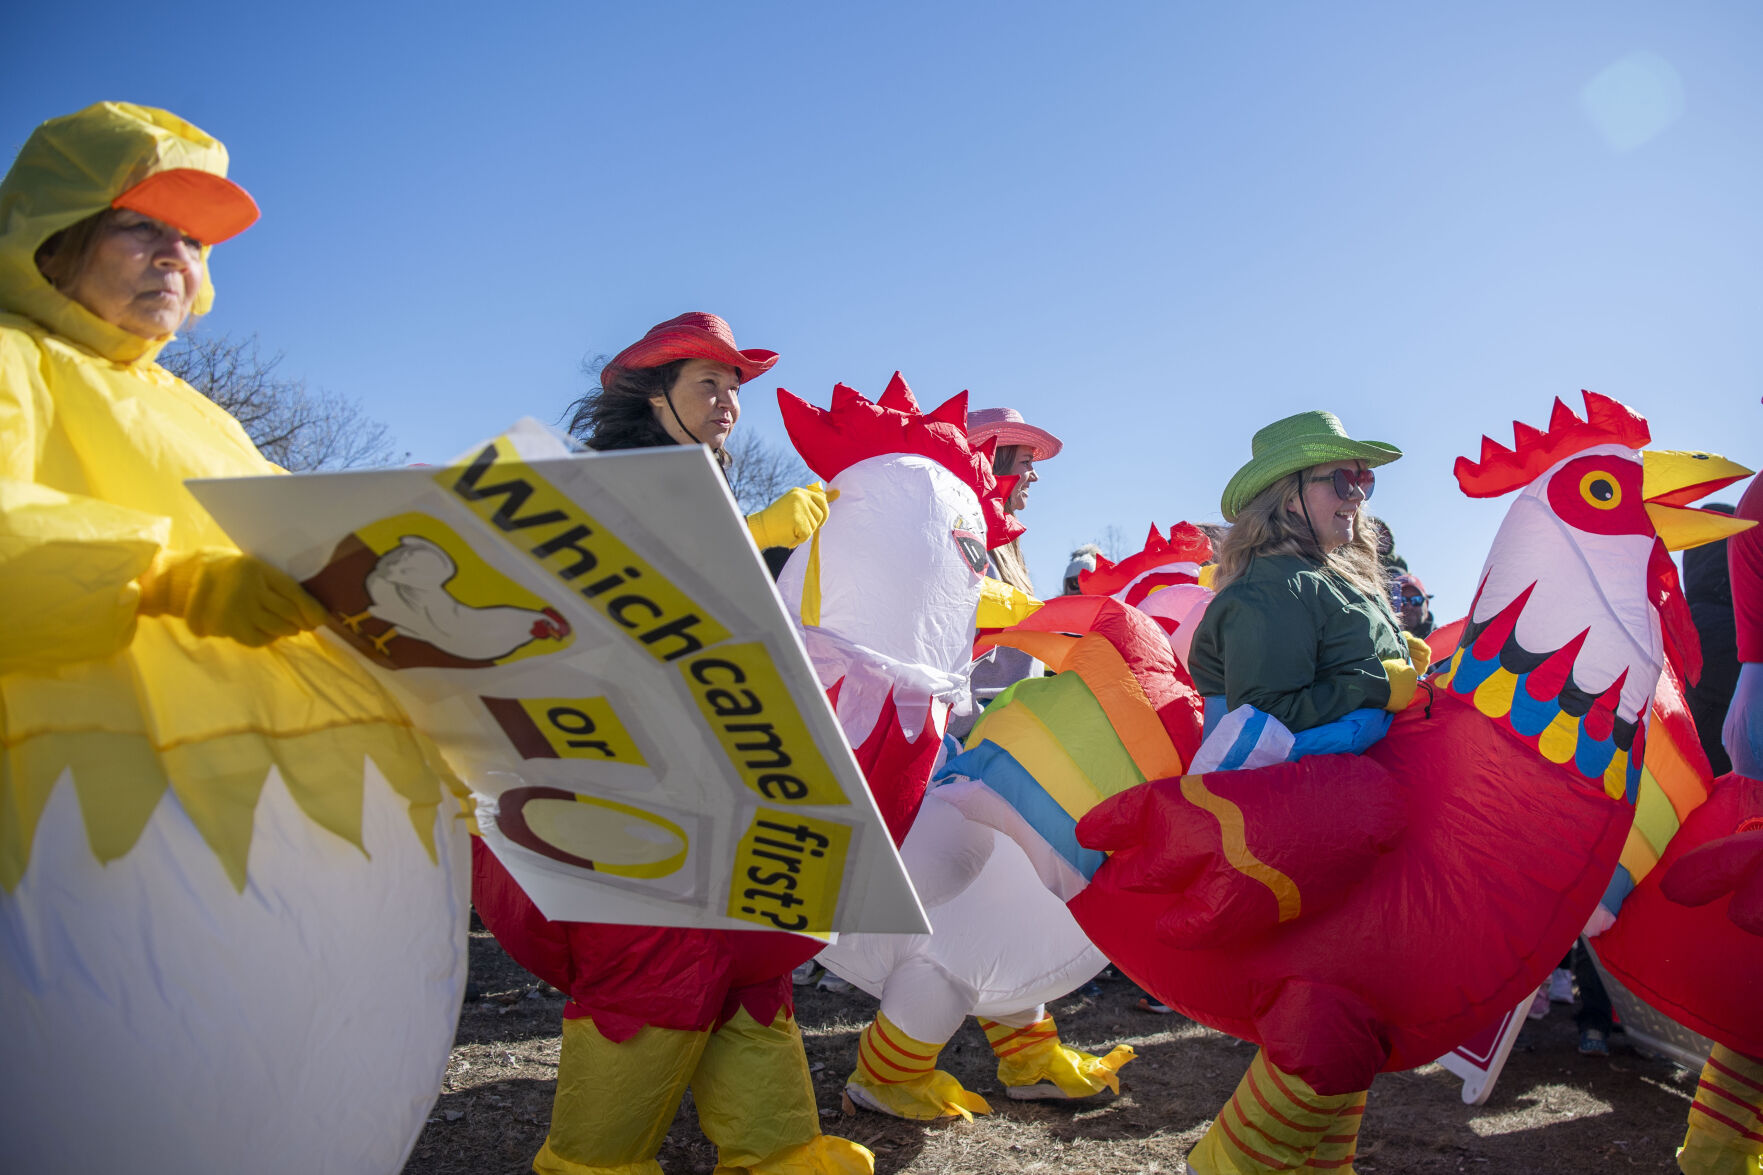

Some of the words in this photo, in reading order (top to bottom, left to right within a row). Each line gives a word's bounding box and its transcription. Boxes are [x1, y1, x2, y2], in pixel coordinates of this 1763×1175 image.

[454, 444, 703, 661] Which
[546, 706, 616, 759] or
[690, 658, 808, 801] came
[741, 819, 829, 933] first?
